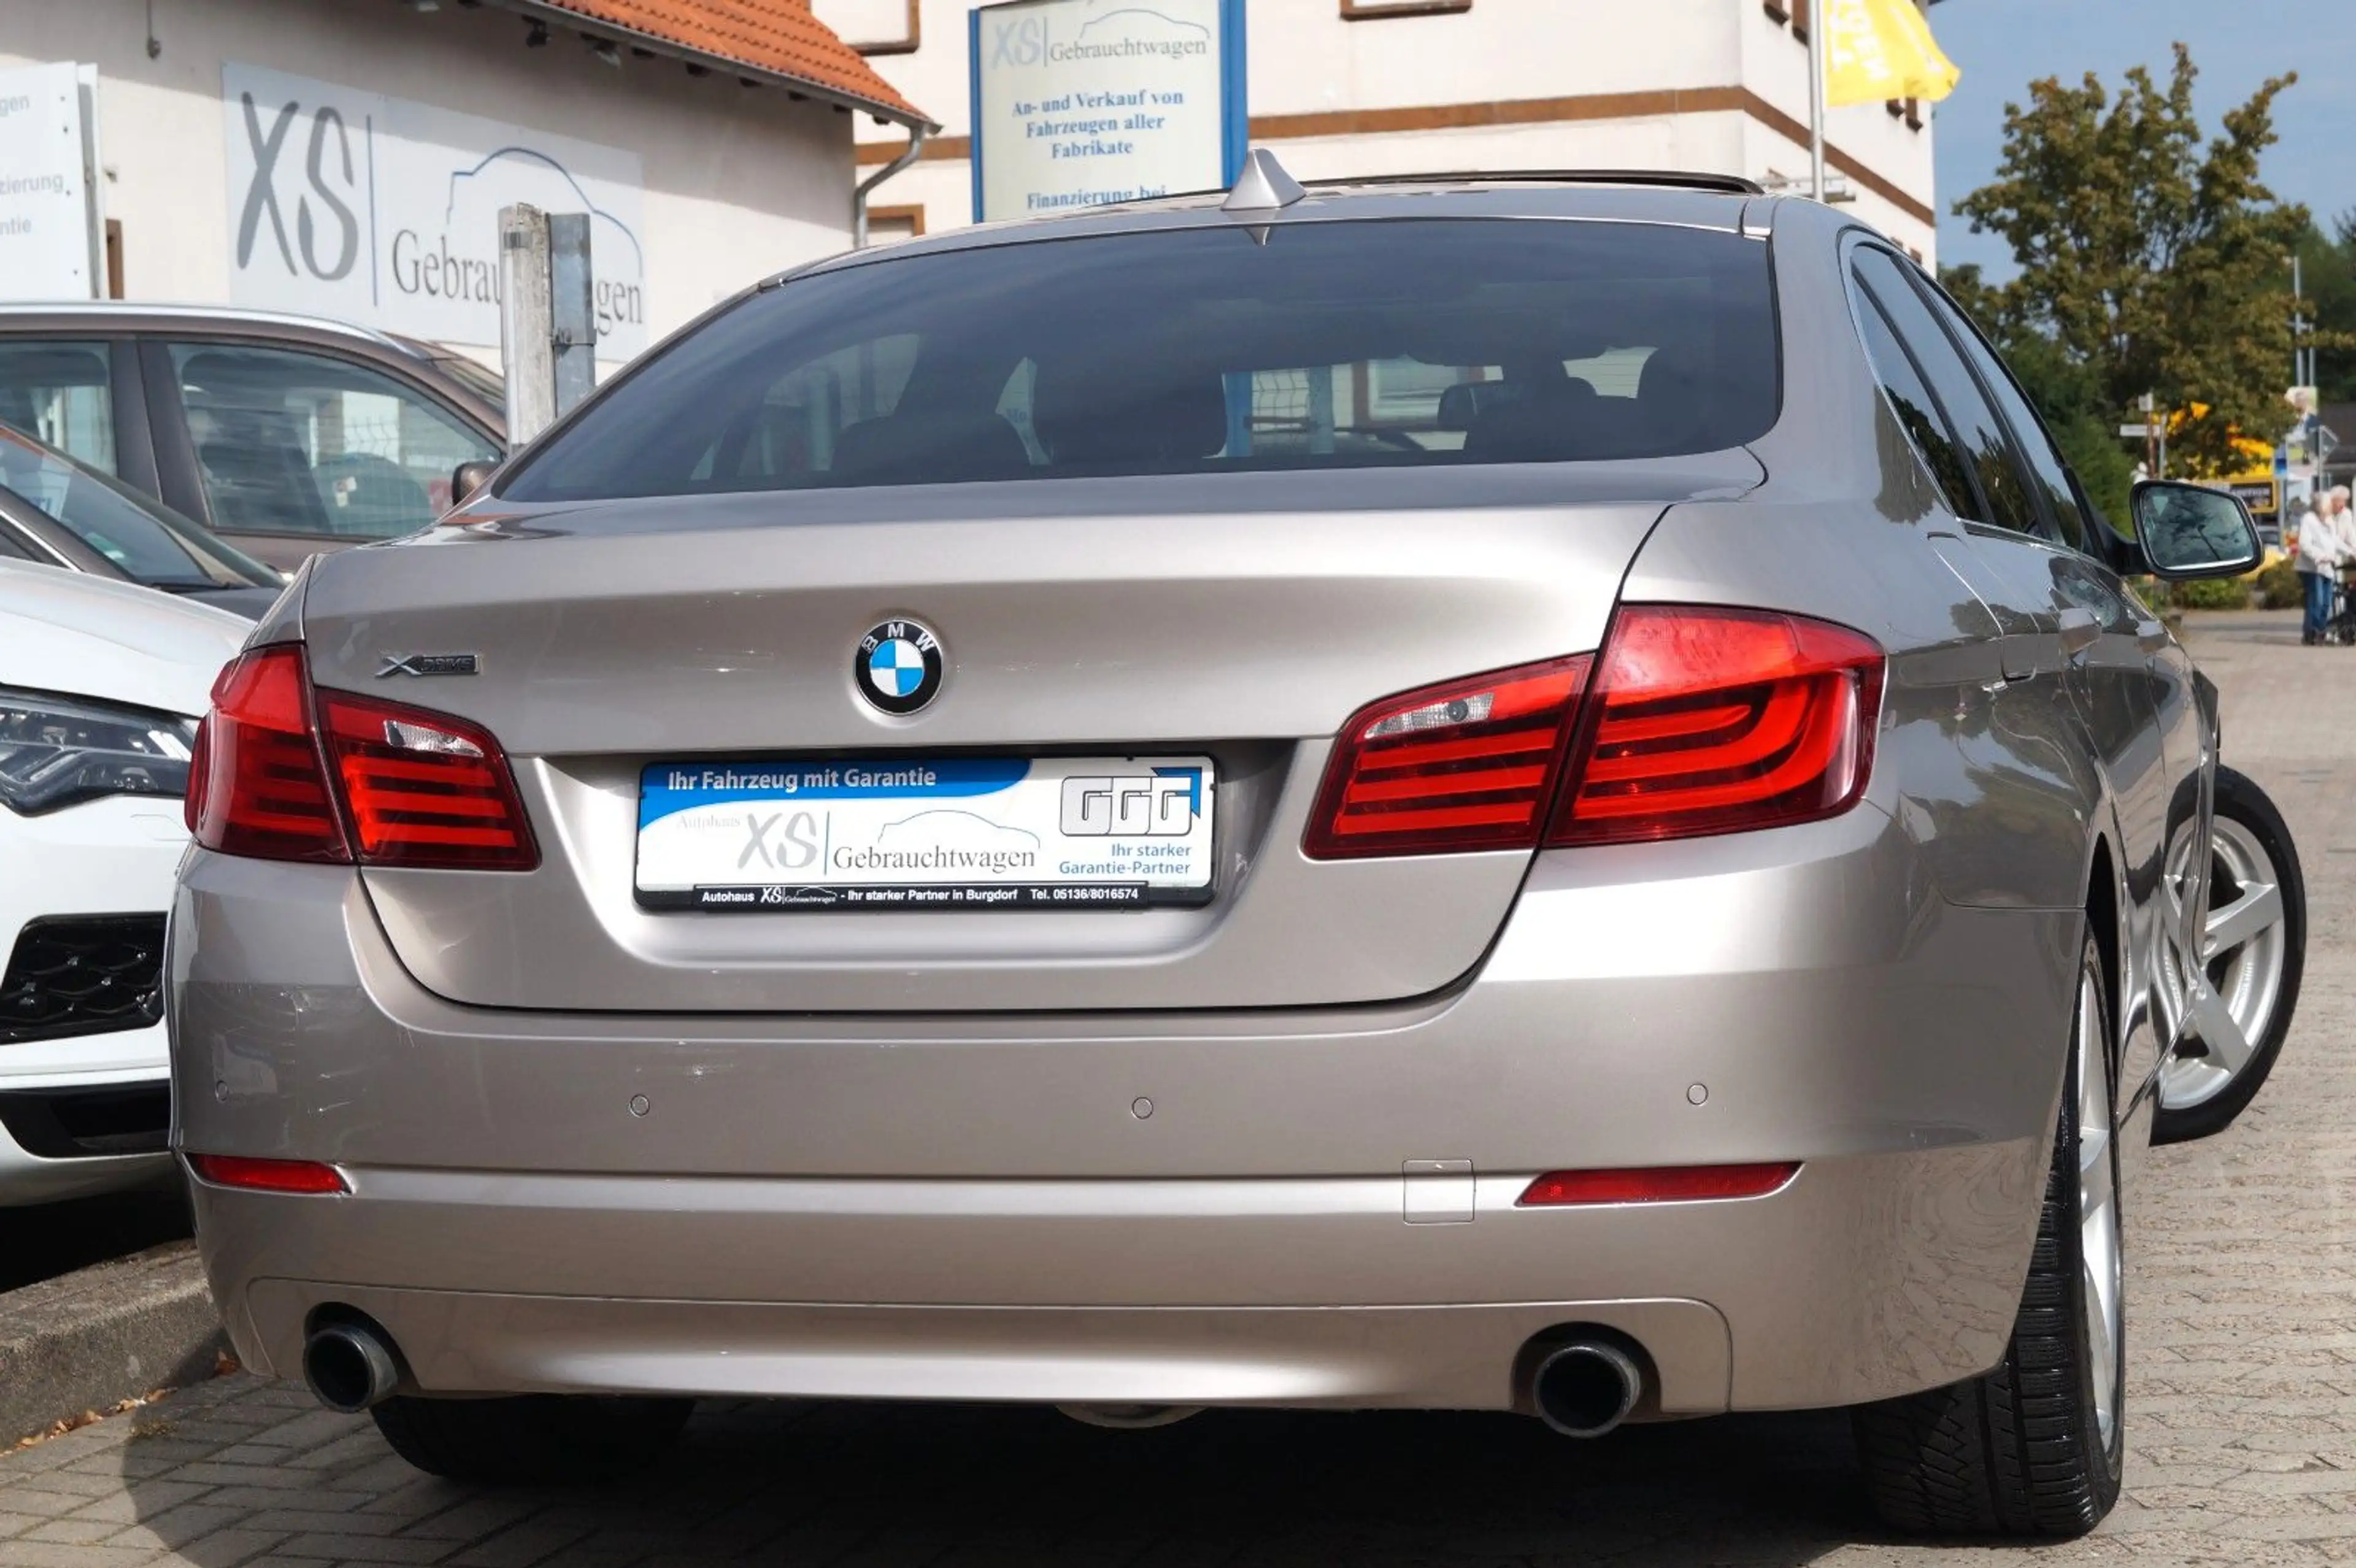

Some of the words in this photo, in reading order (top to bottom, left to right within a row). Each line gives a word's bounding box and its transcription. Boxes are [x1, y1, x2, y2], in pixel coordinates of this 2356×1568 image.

[991, 17, 1042, 69] XS
[1049, 37, 1207, 60] Gebrauchtwagen
[1012, 101, 1037, 117] An-
[1042, 94, 1071, 113] und
[1076, 89, 1147, 109] Verkauf
[1152, 91, 1184, 105] von
[1026, 119, 1118, 138] Fahrzeugen
[1123, 114, 1165, 130] aller
[1052, 139, 1134, 159] Fabrikate
[236, 91, 359, 281] XS
[861, 622, 936, 654] BMW
[668, 771, 698, 790] Ihr
[702, 769, 798, 793] Fahrzeug
[804, 769, 839, 787] mit
[844, 767, 937, 787] Garantie
[677, 814, 741, 829] Autohaus
[737, 812, 818, 869] XS
[833, 845, 1035, 873] Gebrauchtwagen
[1111, 844, 1133, 857] Ihr
[1137, 843, 1191, 857] starker
[1058, 861, 1191, 875] Garantie-Partner
[702, 891, 755, 902] Autohaus
[760, 887, 782, 904] XS
[848, 890, 863, 901] Ihr
[866, 890, 906, 901] starker
[908, 890, 950, 901] Partner
[952, 890, 963, 900] in
[966, 890, 1018, 902] Burgdorf
[1030, 889, 1050, 899] Tel.
[1053, 889, 1138, 900] 05136/8016574
